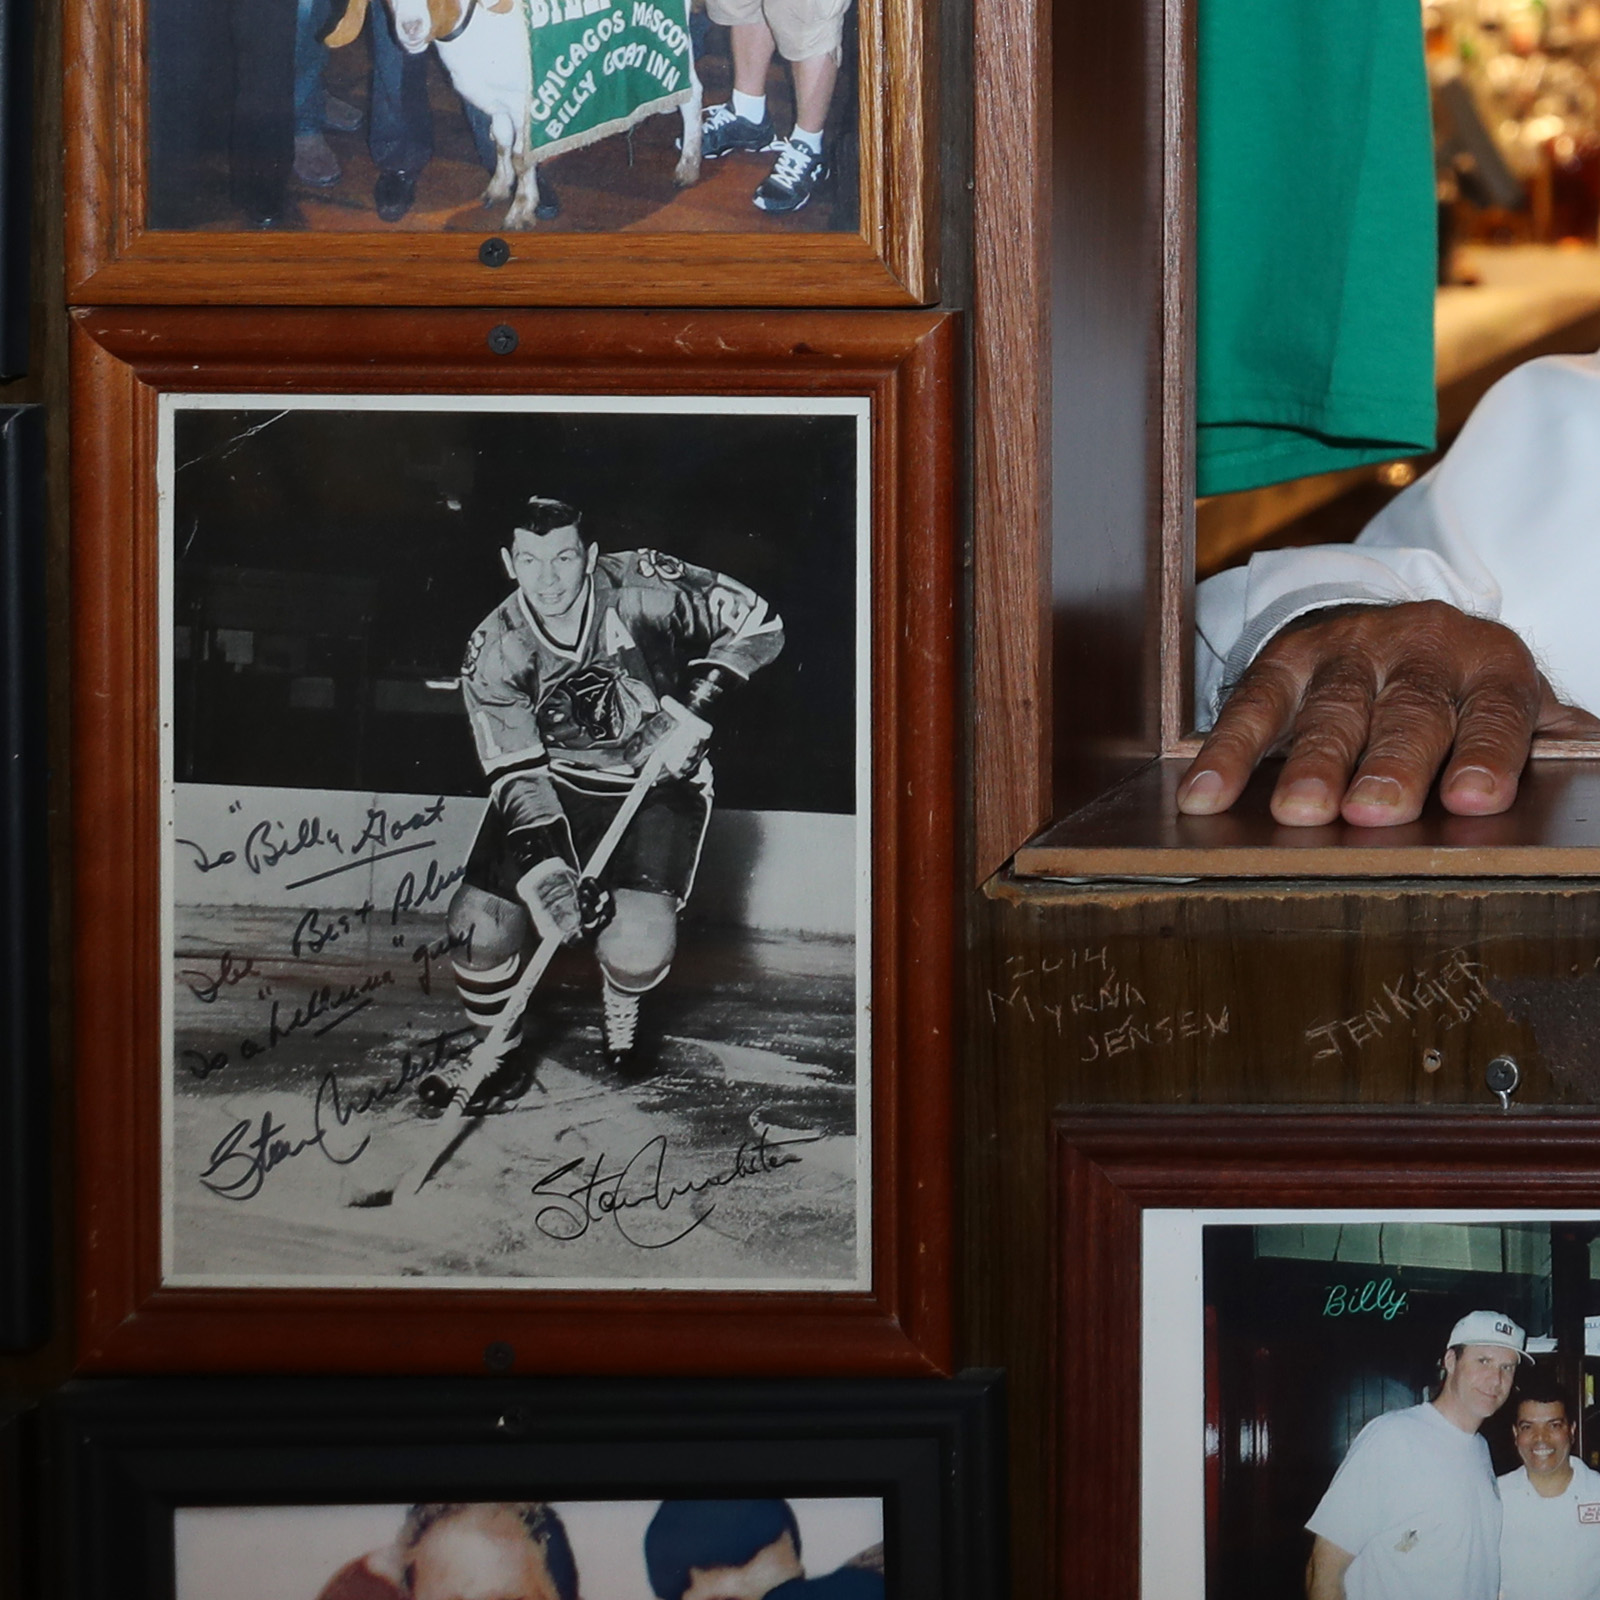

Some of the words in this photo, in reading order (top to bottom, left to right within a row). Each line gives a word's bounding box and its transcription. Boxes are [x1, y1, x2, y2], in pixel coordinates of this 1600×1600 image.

[530, 9, 626, 121] CHICAGOS
[631, 1, 690, 57] MASCOT
[545, 70, 597, 139] BILLY
[602, 42, 648, 76] GOAT
[645, 49, 681, 92] INN
[606, 606, 636, 657] A
[1322, 1277, 1407, 1321] Billy
[1494, 1321, 1515, 1335] CAT
